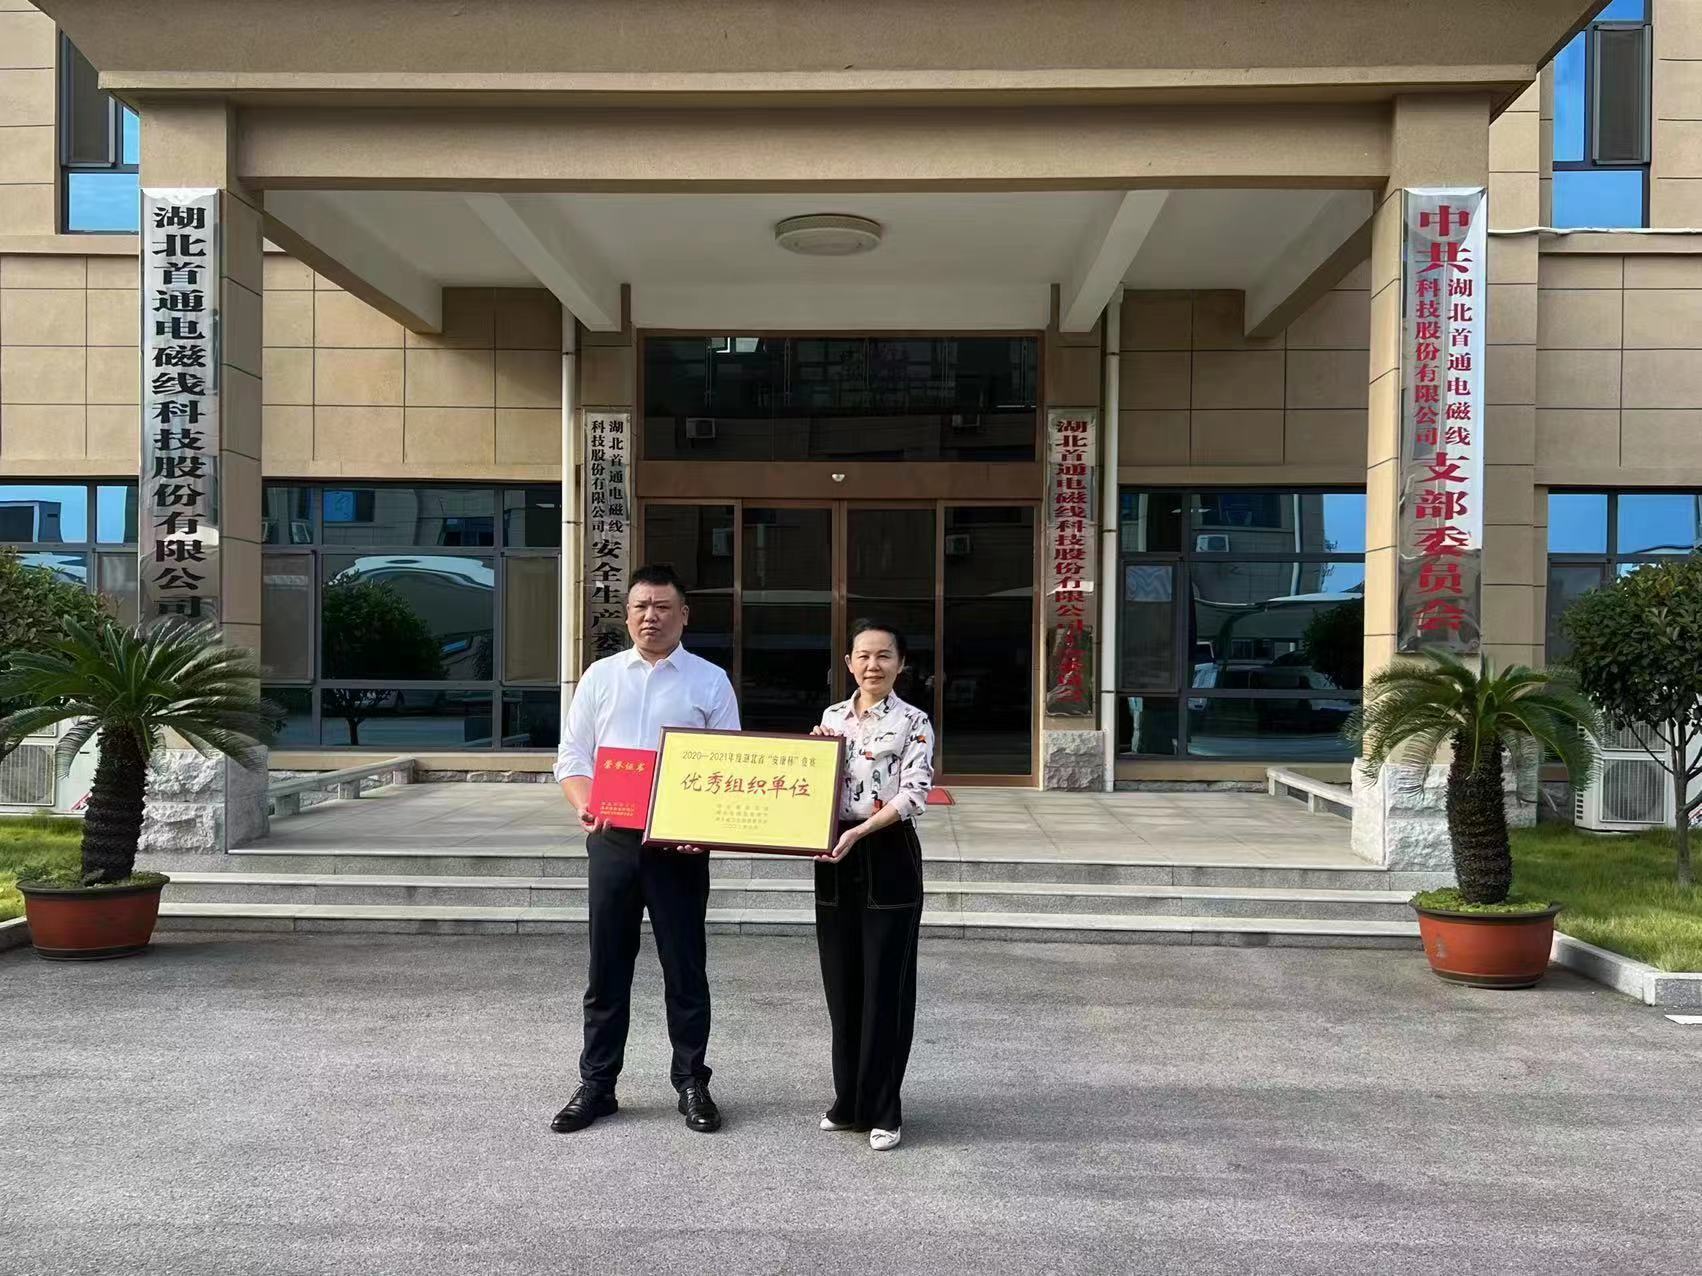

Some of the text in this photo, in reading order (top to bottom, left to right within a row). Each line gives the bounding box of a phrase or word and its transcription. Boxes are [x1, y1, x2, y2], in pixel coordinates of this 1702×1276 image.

[1415, 205, 1473, 274] 中共
[152, 206, 207, 618] 湖北首通电磁线科技股份有限公司
[1414, 278, 1441, 446] 科技股份有限公司
[1446, 278, 1473, 446] 湖北首通电磁线
[591, 420, 606, 533] 科技股份有限公司
[608, 420, 624, 533] 湖北首通电磁线
[591, 539, 622, 660] 安全生产委
[1412, 452, 1470, 631] 支部委员会
[680, 771, 811, 799] 优秀组织单位
